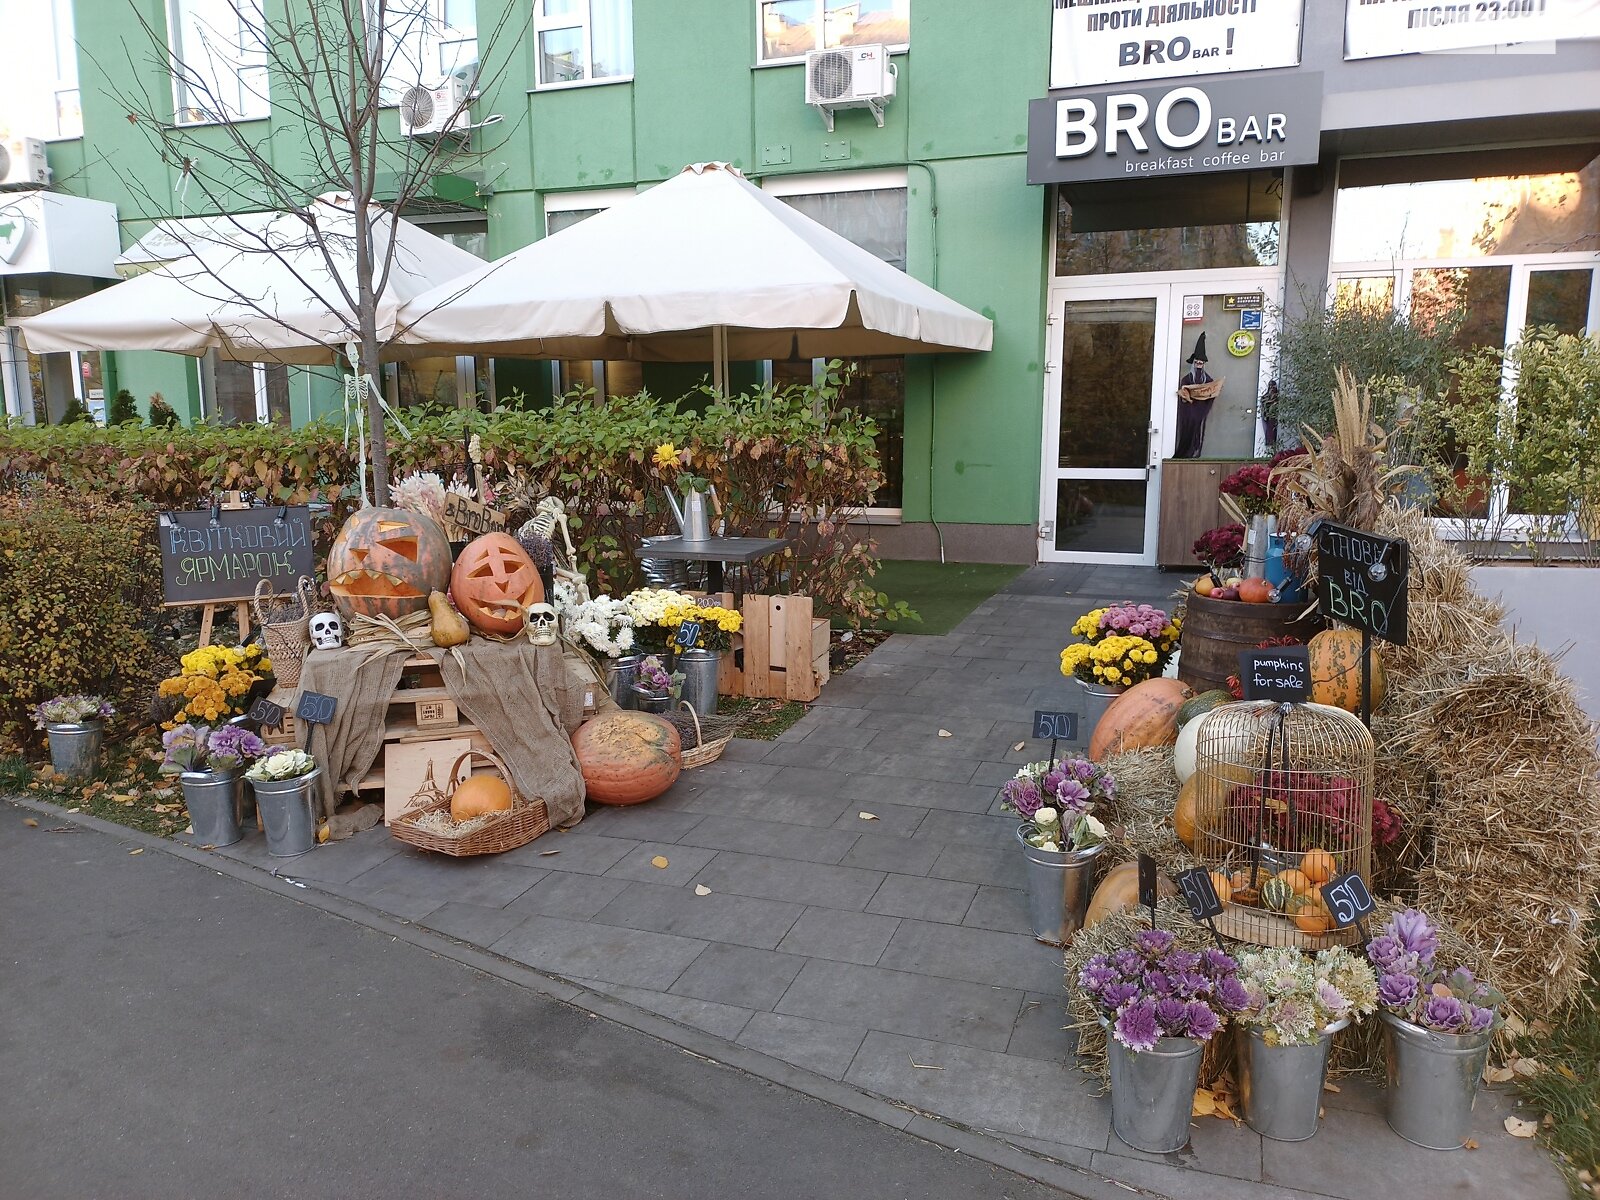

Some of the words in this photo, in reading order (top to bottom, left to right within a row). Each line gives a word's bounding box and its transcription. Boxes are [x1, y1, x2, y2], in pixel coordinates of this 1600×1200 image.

[1087, 8, 1142, 32] ПРОТИ
[1145, 0, 1257, 27] ДІЯЛЬНОСТІ
[1407, 4, 1471, 29] ПІСЛЯ
[1475, 0, 1535, 22] 23:00
[1118, 36, 1191, 67] BRO
[1192, 47, 1220, 59] BAR
[1055, 86, 1212, 159] BRO
[1217, 113, 1288, 147] BAR
[1125, 156, 1194, 173] breakfast
[1203, 151, 1250, 167] coffee
[1259, 149, 1286, 163] bar
[169, 517, 306, 554] КВІТКОВИЙ
[175, 550, 296, 586] ЯРМАРОК
[1323, 575, 1389, 634] BRO
[677, 621, 700, 646] 50
[1253, 658, 1304, 672] pumpkins
[1253, 672, 1273, 687] for
[251, 700, 281, 725] 50
[301, 695, 333, 720] 50
[1039, 713, 1071, 739] 50
[1181, 870, 1219, 916] 50
[1330, 874, 1372, 923] 50
